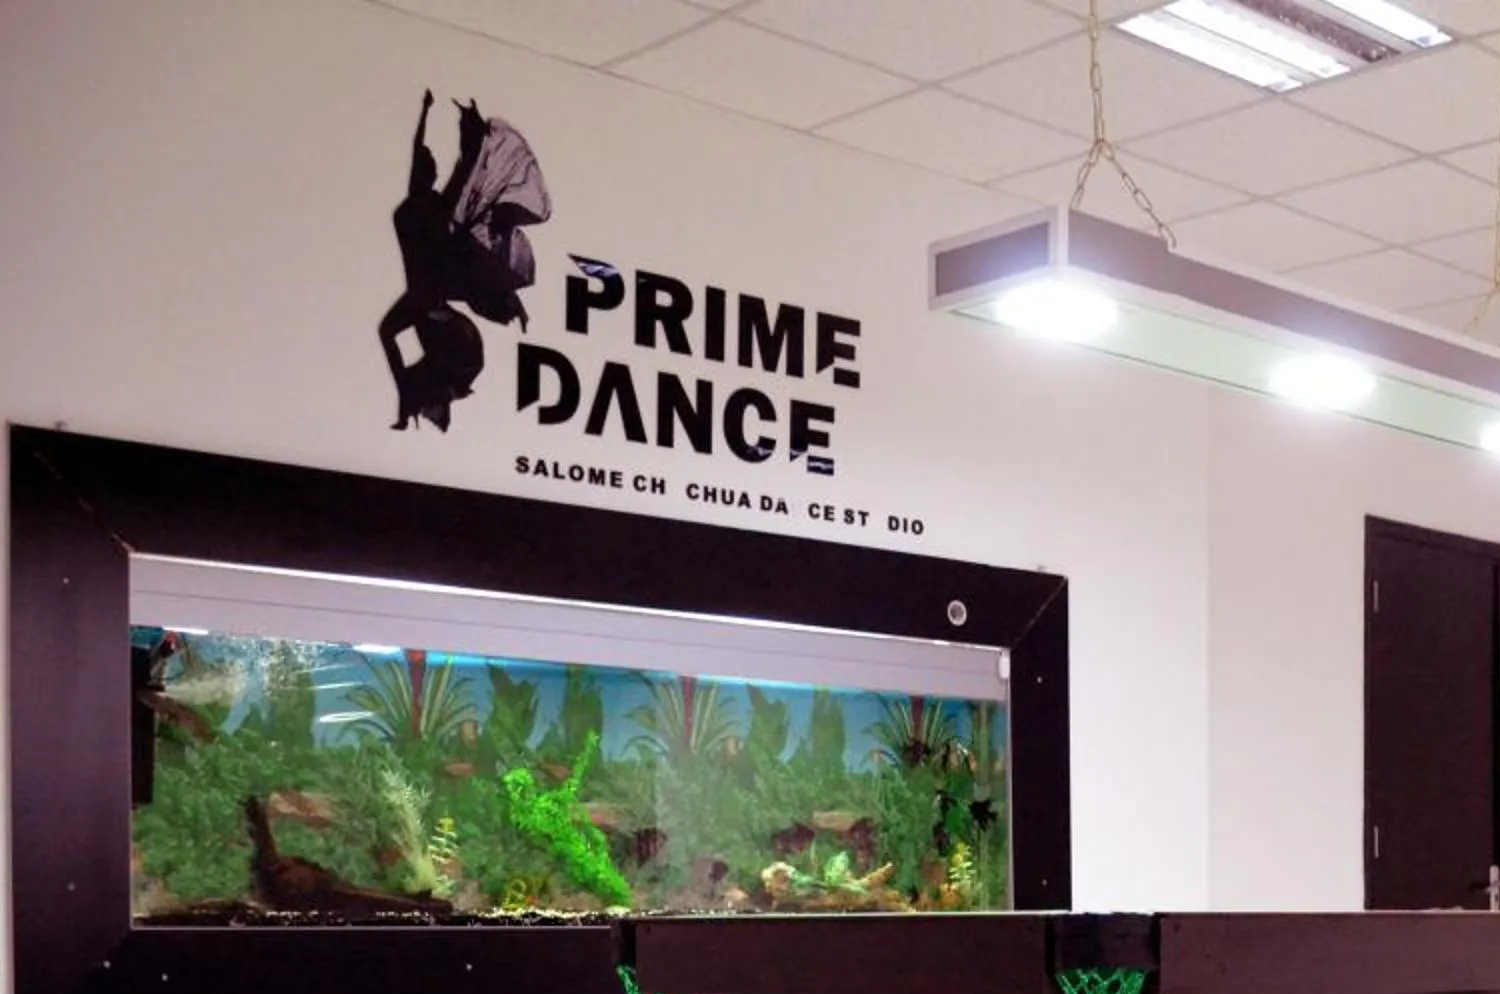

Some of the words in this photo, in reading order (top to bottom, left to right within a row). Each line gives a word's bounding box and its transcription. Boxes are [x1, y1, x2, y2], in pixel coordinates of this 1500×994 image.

[565, 253, 861, 389] PRIME
[515, 455, 624, 489] SALOME
[516, 341, 836, 477] DANCE
